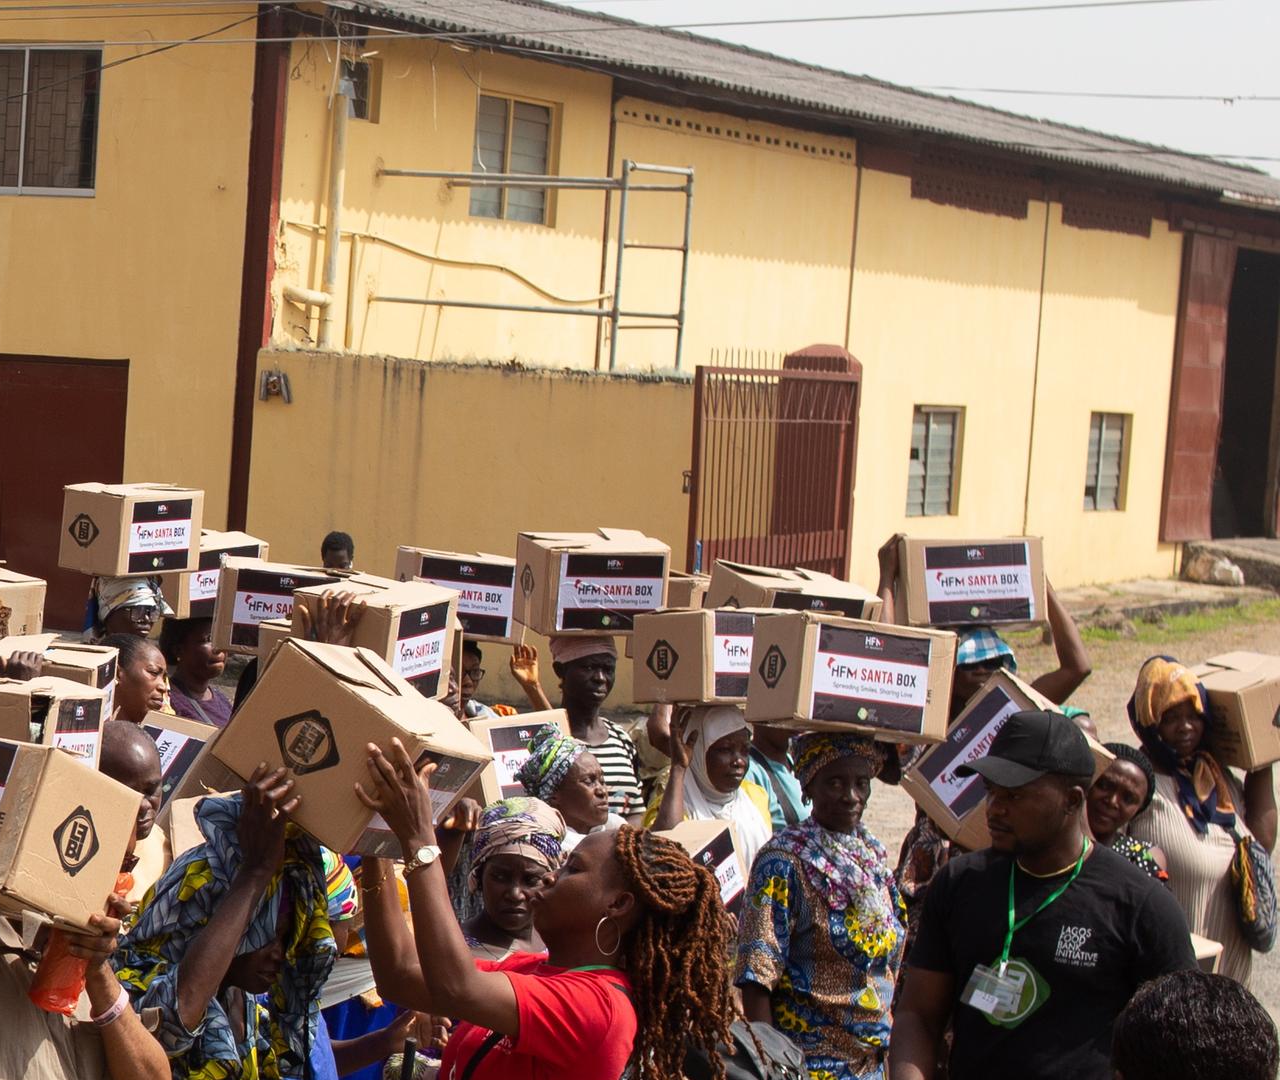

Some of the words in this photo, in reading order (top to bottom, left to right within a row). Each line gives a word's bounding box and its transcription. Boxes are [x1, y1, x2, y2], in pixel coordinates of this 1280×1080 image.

[139, 530, 154, 540] HFM
[154, 528, 173, 538] SANTA
[174, 527, 185, 537] BOX
[200, 577, 216, 587] HFM
[941, 576, 965, 587] HFM
[968, 574, 999, 586] SANTA
[1001, 573, 1019, 585] BOX
[578, 585, 601, 595] HFM
[603, 585, 632, 596] SANTA
[635, 585, 653, 596] BOX
[485, 592, 503, 604] BOX
[248, 602, 273, 613] HFM
[727, 646, 749, 657] HFM
[831, 665, 858, 679] HFM
[861, 670, 894, 685] SANTA
[897, 673, 917, 688] BOX
[967, 733, 995, 762] SANTA
[1061, 925, 1093, 938] LAGOS
[1058, 933, 1086, 945] FOOD
[1057, 940, 1082, 951] BANK
[1054, 949, 1099, 962] INITIATIVE
